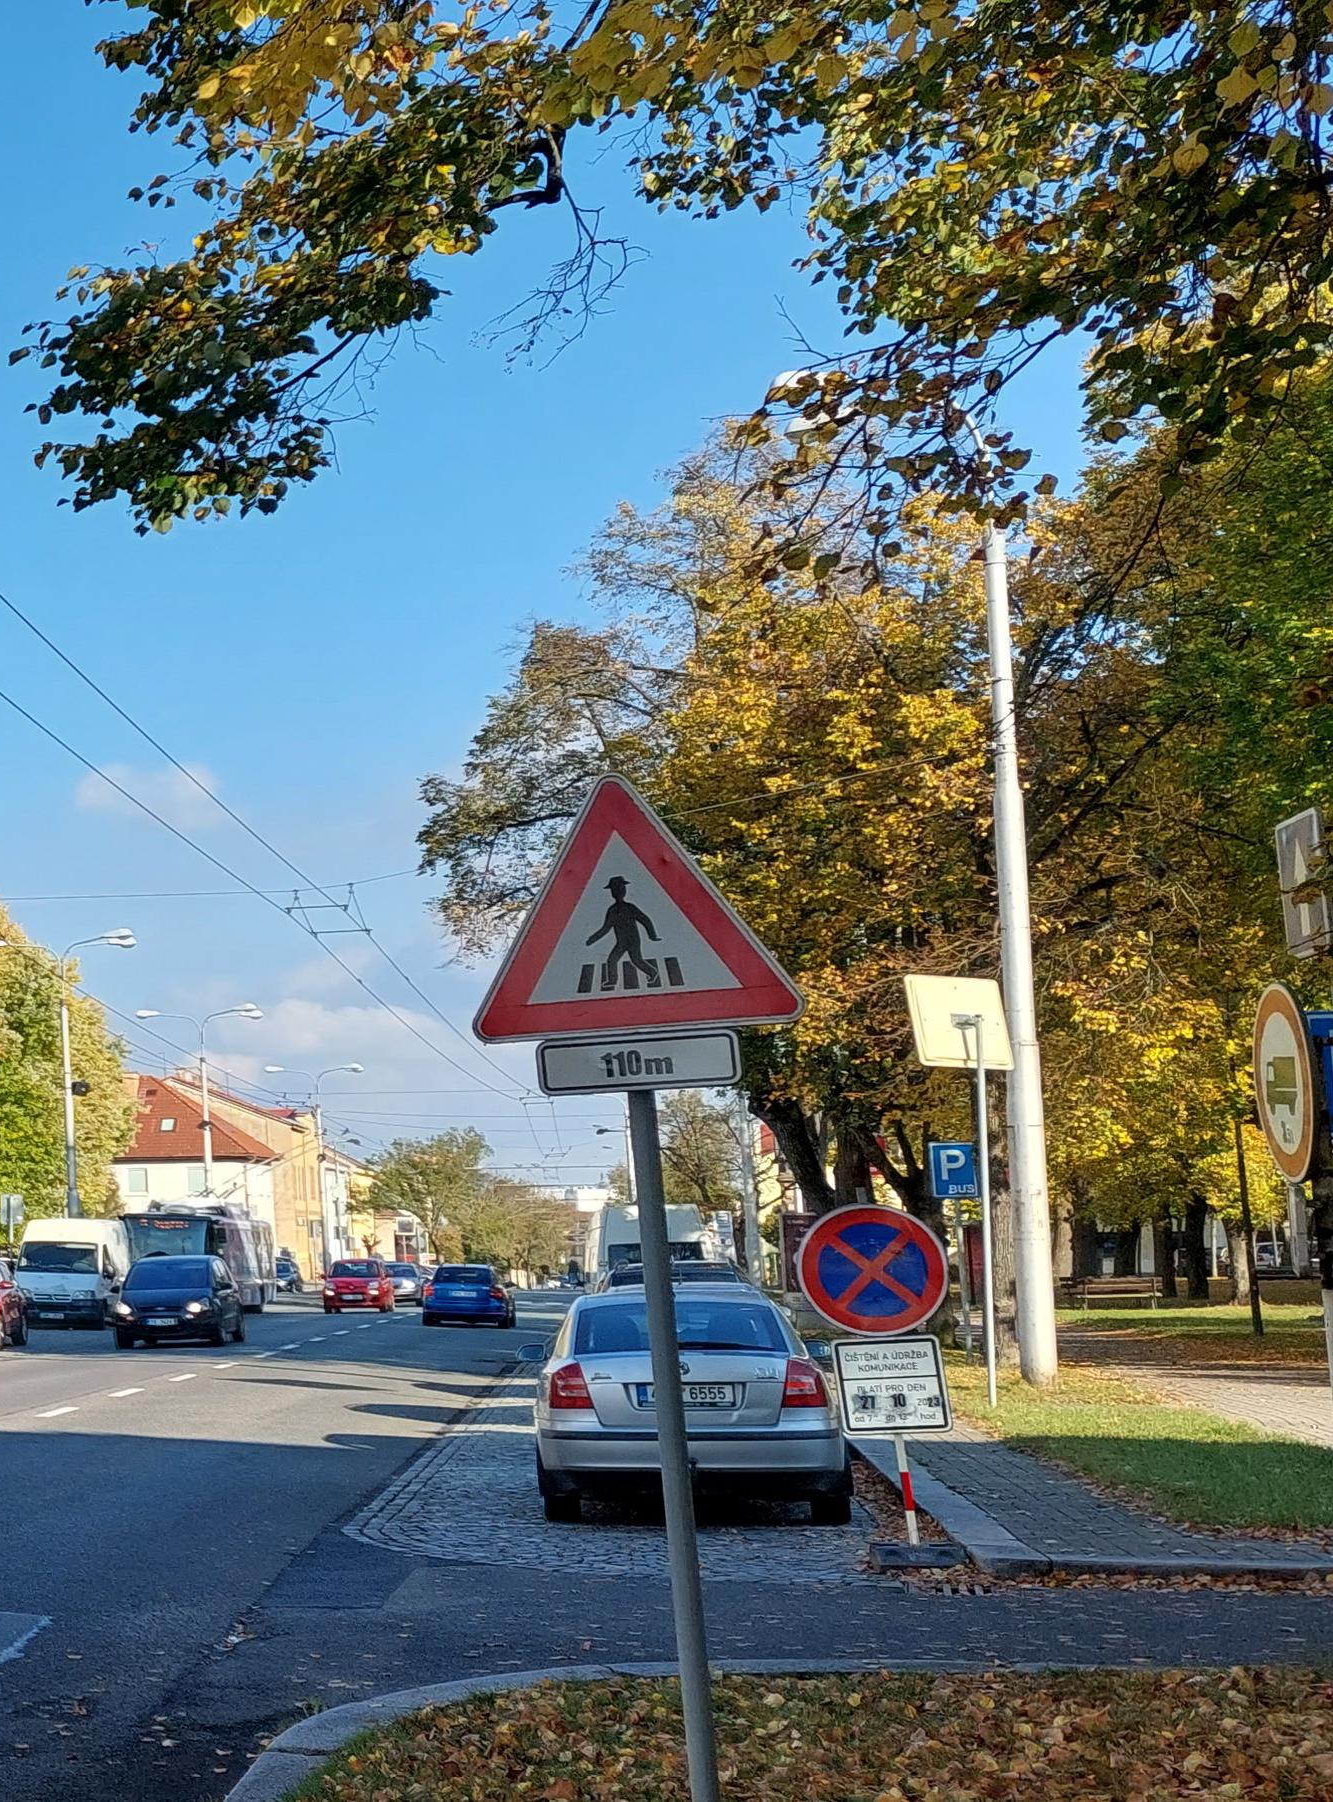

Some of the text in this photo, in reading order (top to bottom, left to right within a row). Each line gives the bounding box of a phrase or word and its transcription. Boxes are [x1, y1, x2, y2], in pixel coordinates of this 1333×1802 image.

[600, 1049, 674, 1079] 110m
[939, 1149, 966, 1181] P
[948, 1184, 974, 1194] BUS
[844, 1349, 929, 1362] ČIŠTĚNÍ A ÚDRŽBA
[858, 1362, 919, 1373] KOMUNIKACE
[690, 1387, 726, 1400] 6555
[885, 1384, 904, 1393] PRO
[907, 1383, 927, 1392] DEN
[890, 1393, 906, 1407] 10
